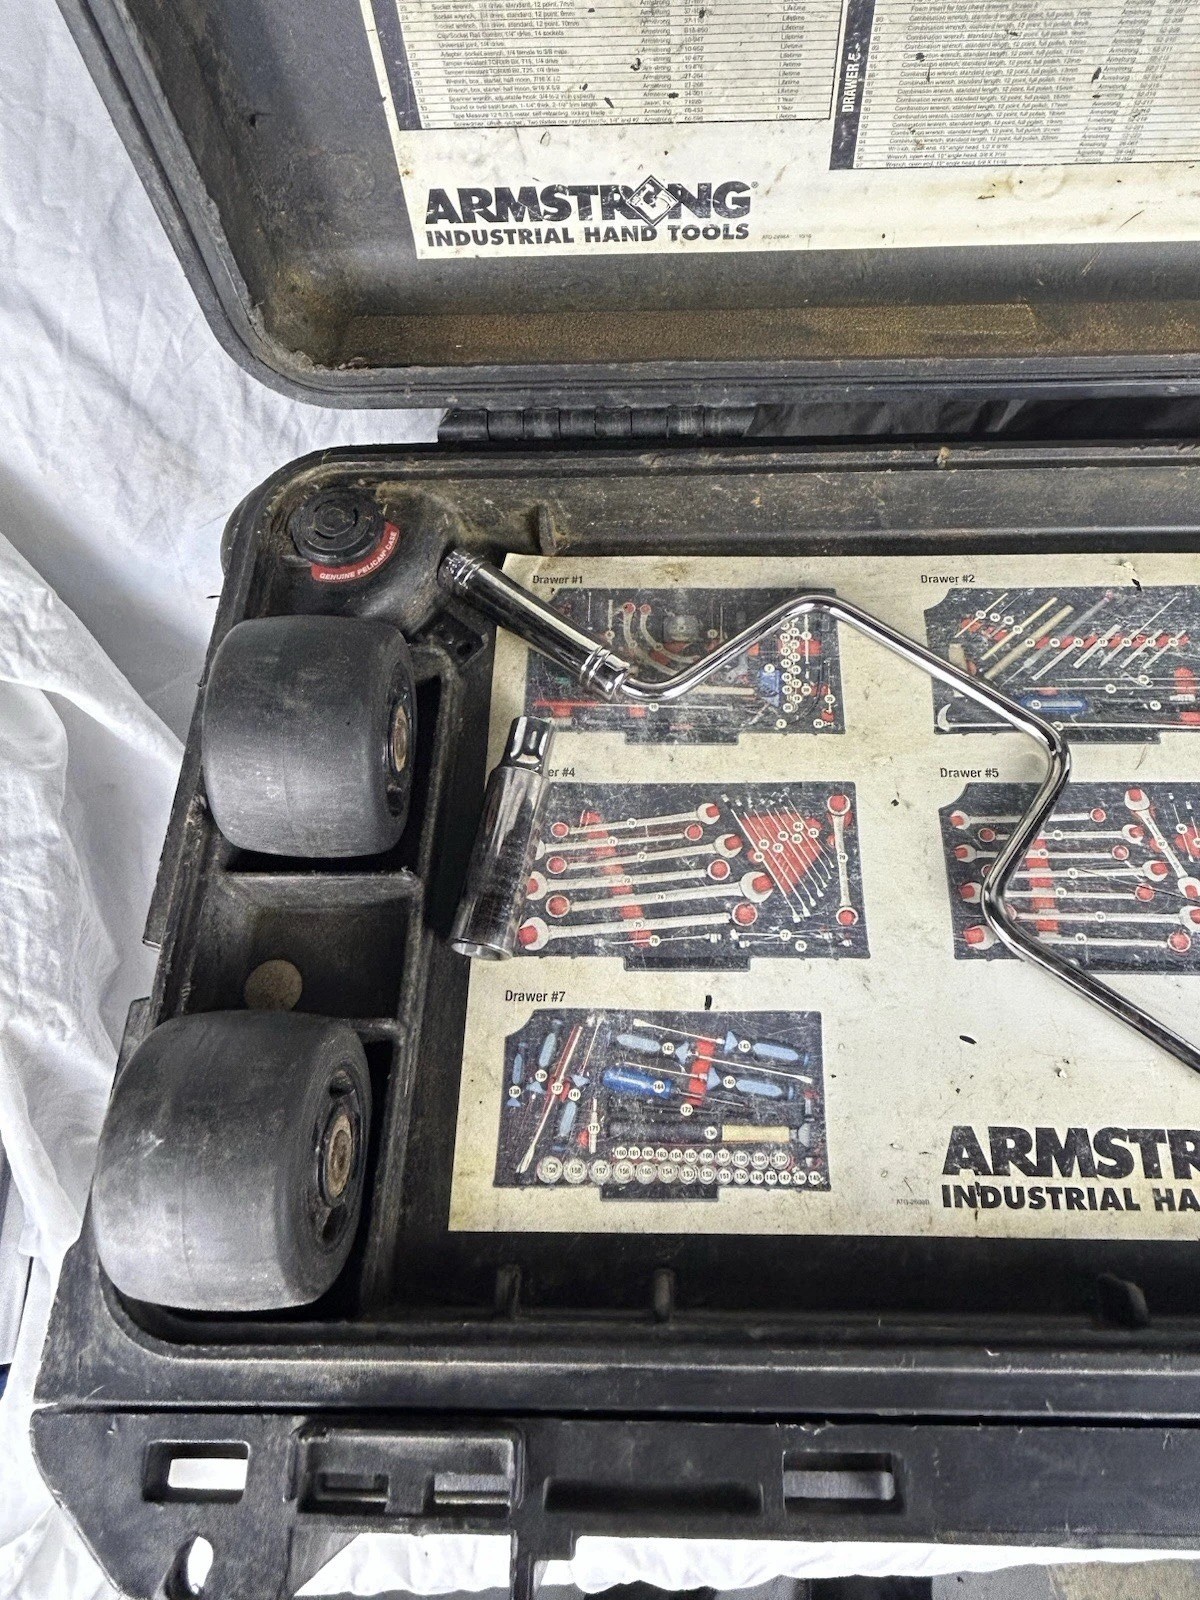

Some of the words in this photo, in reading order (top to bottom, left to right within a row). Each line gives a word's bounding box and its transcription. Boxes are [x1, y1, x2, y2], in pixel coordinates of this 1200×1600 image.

[842, 63, 860, 112] DRAWER
[426, 228, 574, 246] INDUSTRIAL
[584, 226, 658, 242] HAND
[668, 223, 750, 241] TOOLS
[320, 571, 356, 580] GENUINE
[386, 532, 398, 550] CASE
[532, 575, 569, 584] Drawer
[572, 575, 583, 584] #1
[920, 574, 959, 584] Drawer
[962, 574, 976, 583] #2
[562, 768, 576, 777] #4
[940, 768, 982, 778] Drawer
[985, 768, 999, 778] #5
[505, 990, 548, 1002] Drawer
[551, 991, 566, 1002] #7
[942, 1184, 1141, 1210] INDUSTRIAL
[1154, 1188, 1200, 1211] HA
